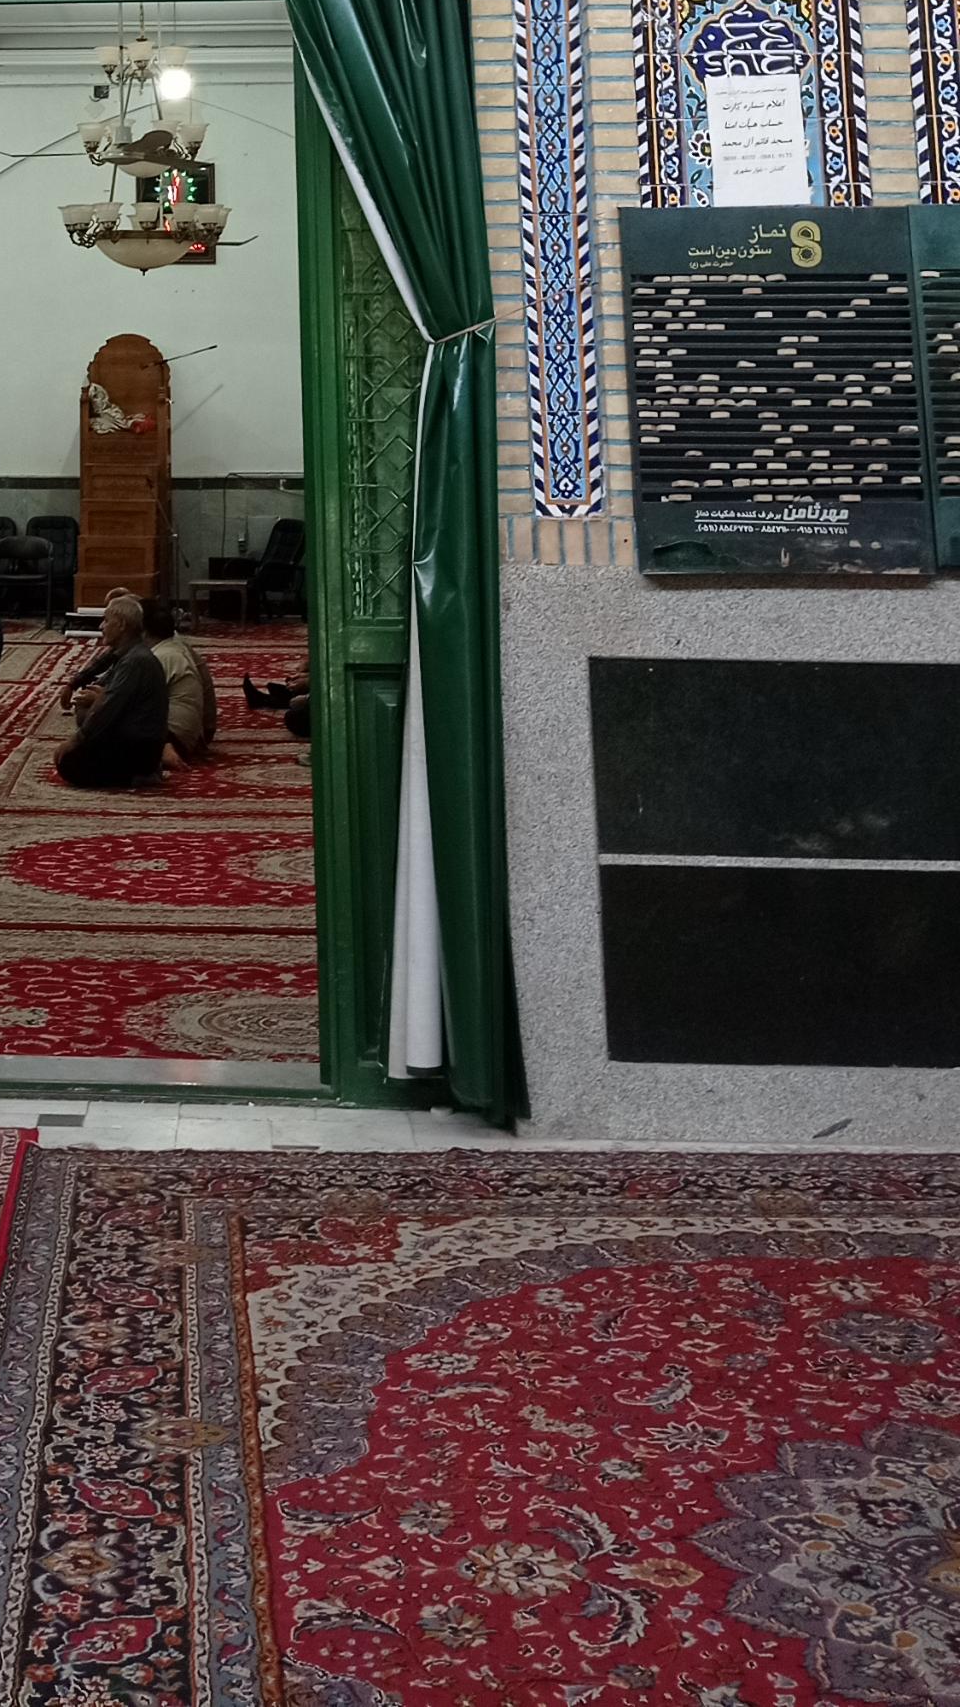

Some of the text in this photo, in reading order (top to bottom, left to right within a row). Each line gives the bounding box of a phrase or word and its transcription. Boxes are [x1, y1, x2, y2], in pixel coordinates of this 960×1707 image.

[748, 223, 787, 244] نماز
[688, 244, 772, 259] ستون دین است
[783, 502, 822, 521] ثامن
[819, 508, 849, 523] مهر
